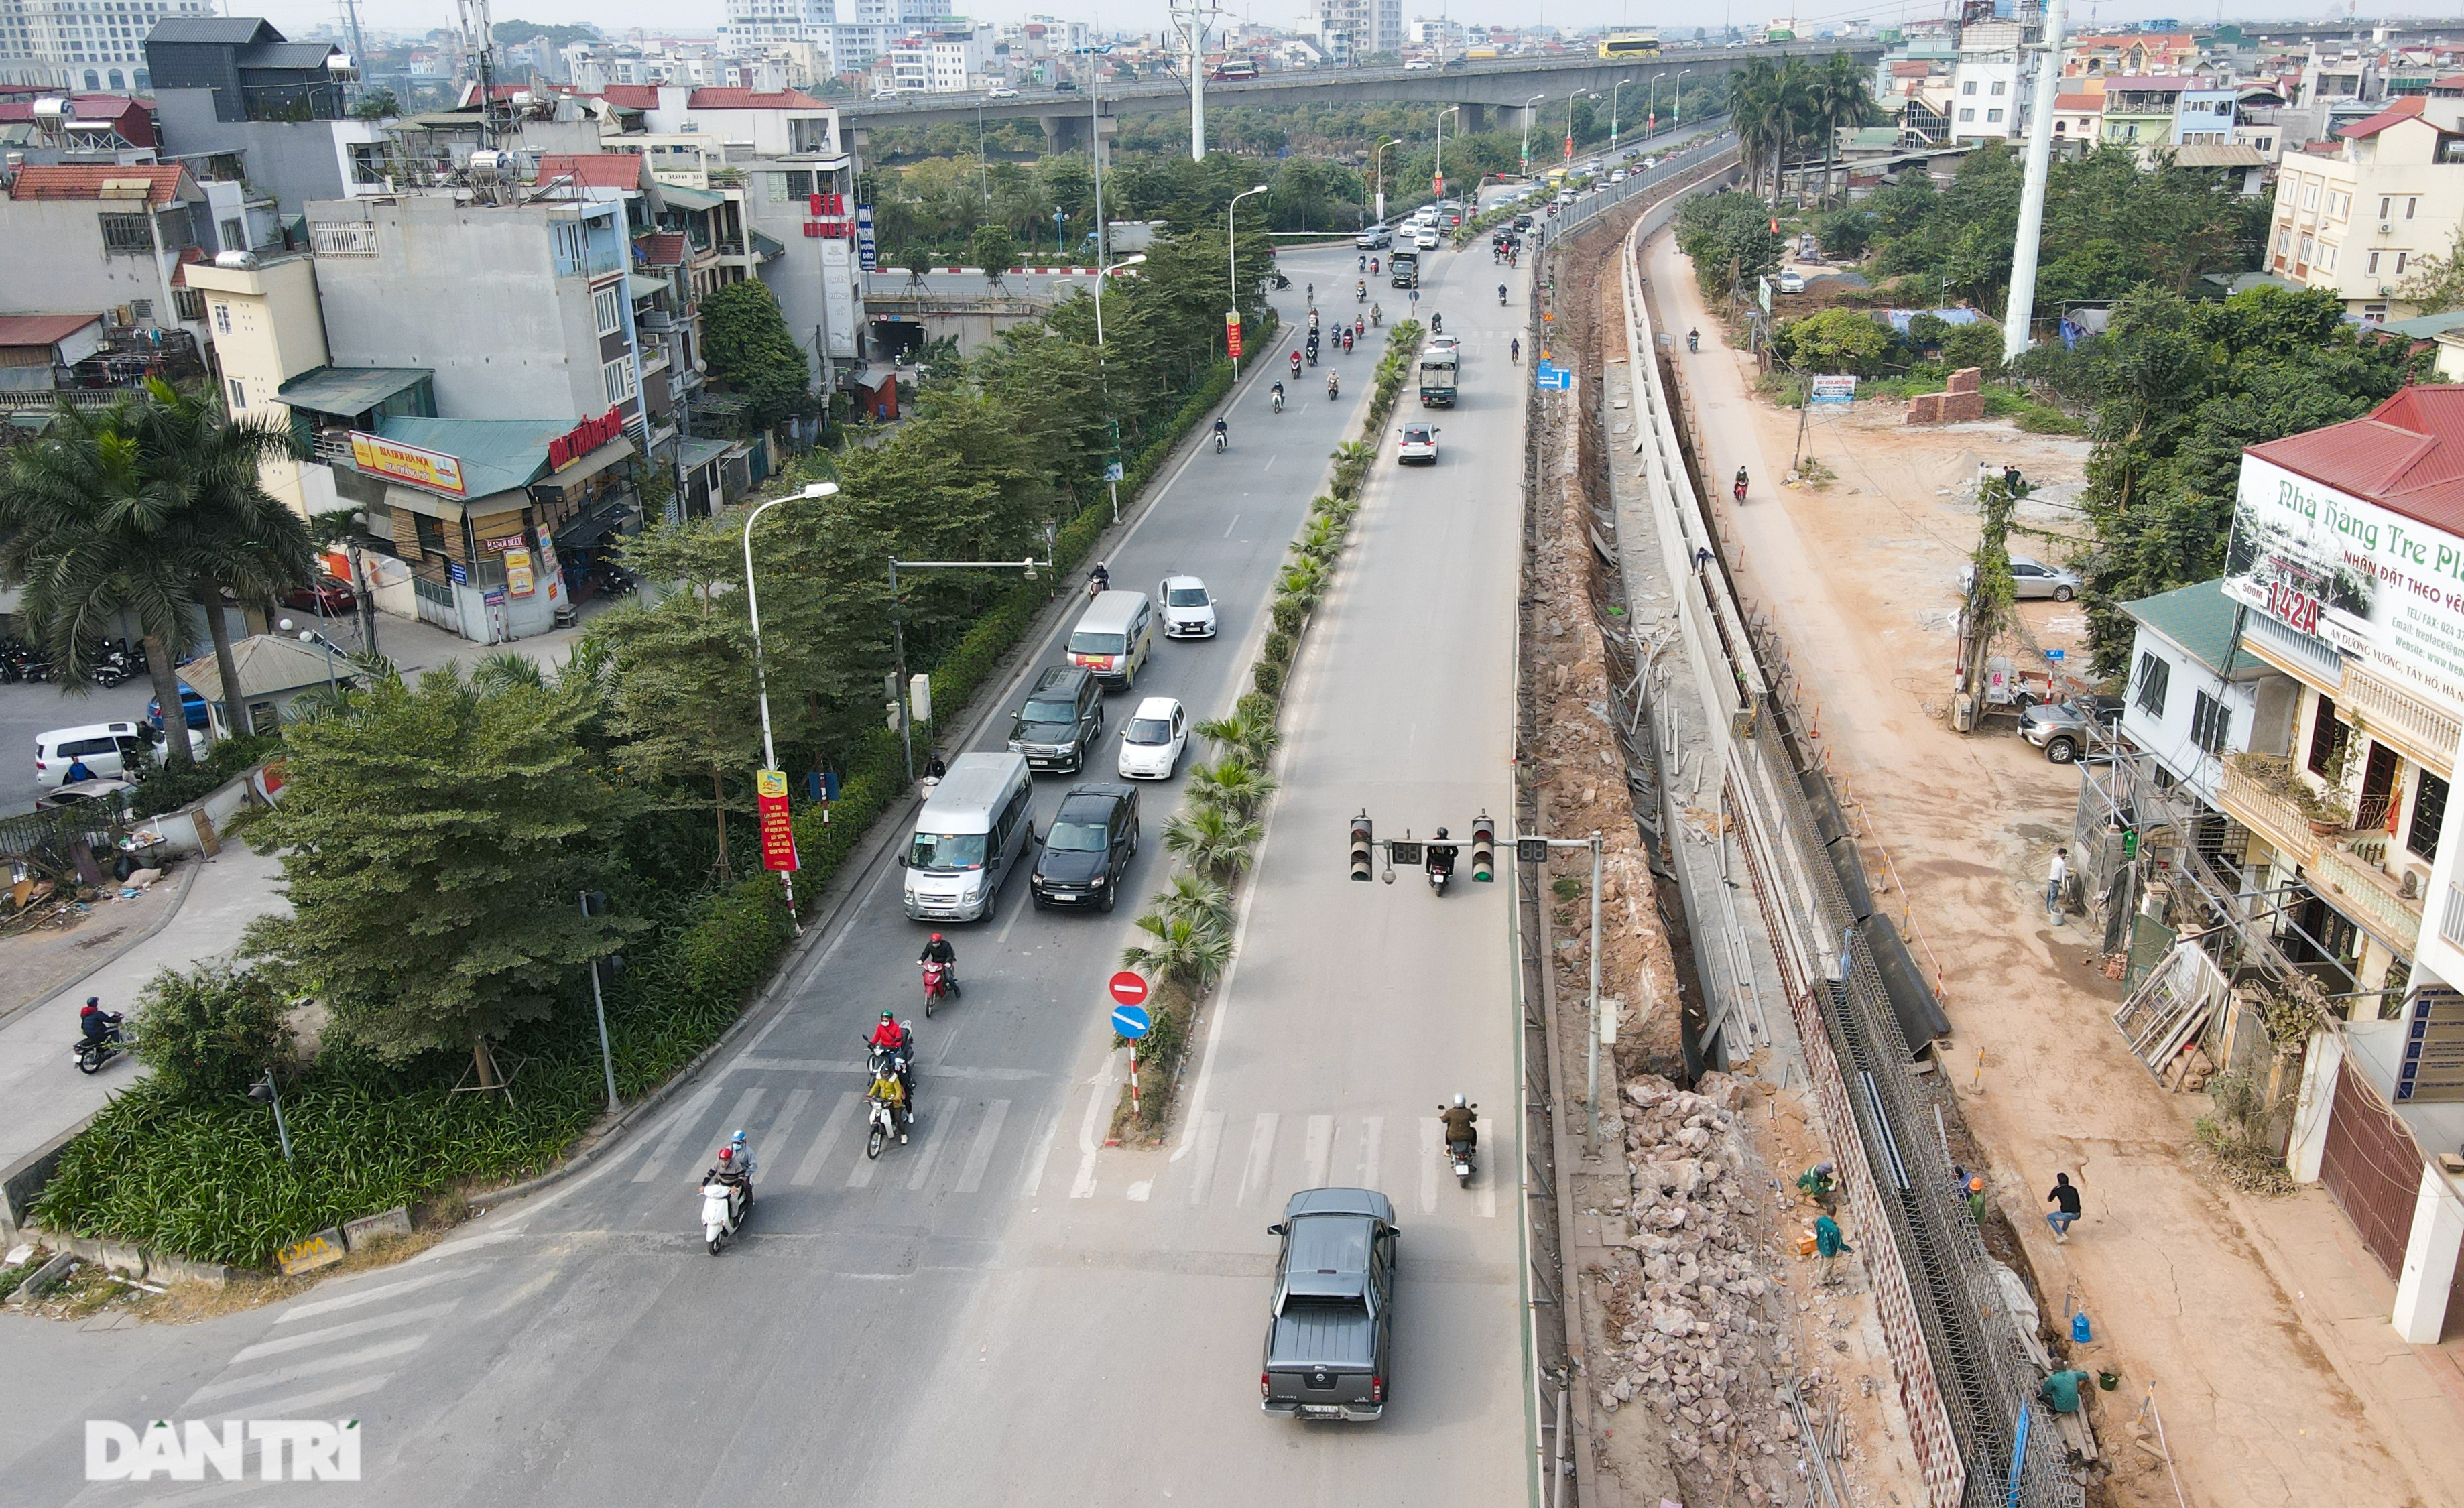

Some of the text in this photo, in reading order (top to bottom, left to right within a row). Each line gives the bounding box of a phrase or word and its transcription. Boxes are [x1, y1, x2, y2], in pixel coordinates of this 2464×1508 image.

[810, 194, 845, 216] BIA
[859, 206, 872, 223] NHÀ
[826, 275, 847, 284] QUÁN
[379, 446, 391, 456] BIA
[405, 452, 416, 463] HÀ
[548, 436, 571, 470] BIA
[385, 462, 395, 473] BIA
[2278, 479, 2317, 520] Nhà
[2323, 498, 2380, 551] Hàng
[2386, 524, 2427, 566] Tre
[2343, 550, 2377, 577] NHẬN
[2380, 566, 2405, 589] ĐẶT
[2408, 577, 2441, 603] THEO
[2243, 582, 2263, 599] 500M
[2270, 581, 2318, 637] 142A
[2392, 616, 2414, 637] Email:
[2422, 613, 2439, 629] FAX:
[2441, 622, 2455, 637] 024
[2394, 635, 2426, 659] Website:
[2330, 629, 2340, 642] AN
[2342, 633, 2371, 656] DƯƠNG
[2406, 664, 2424, 682] TÂY
[2442, 683, 2455, 699] HÀ
[277, 1237, 330, 1265] GYM
